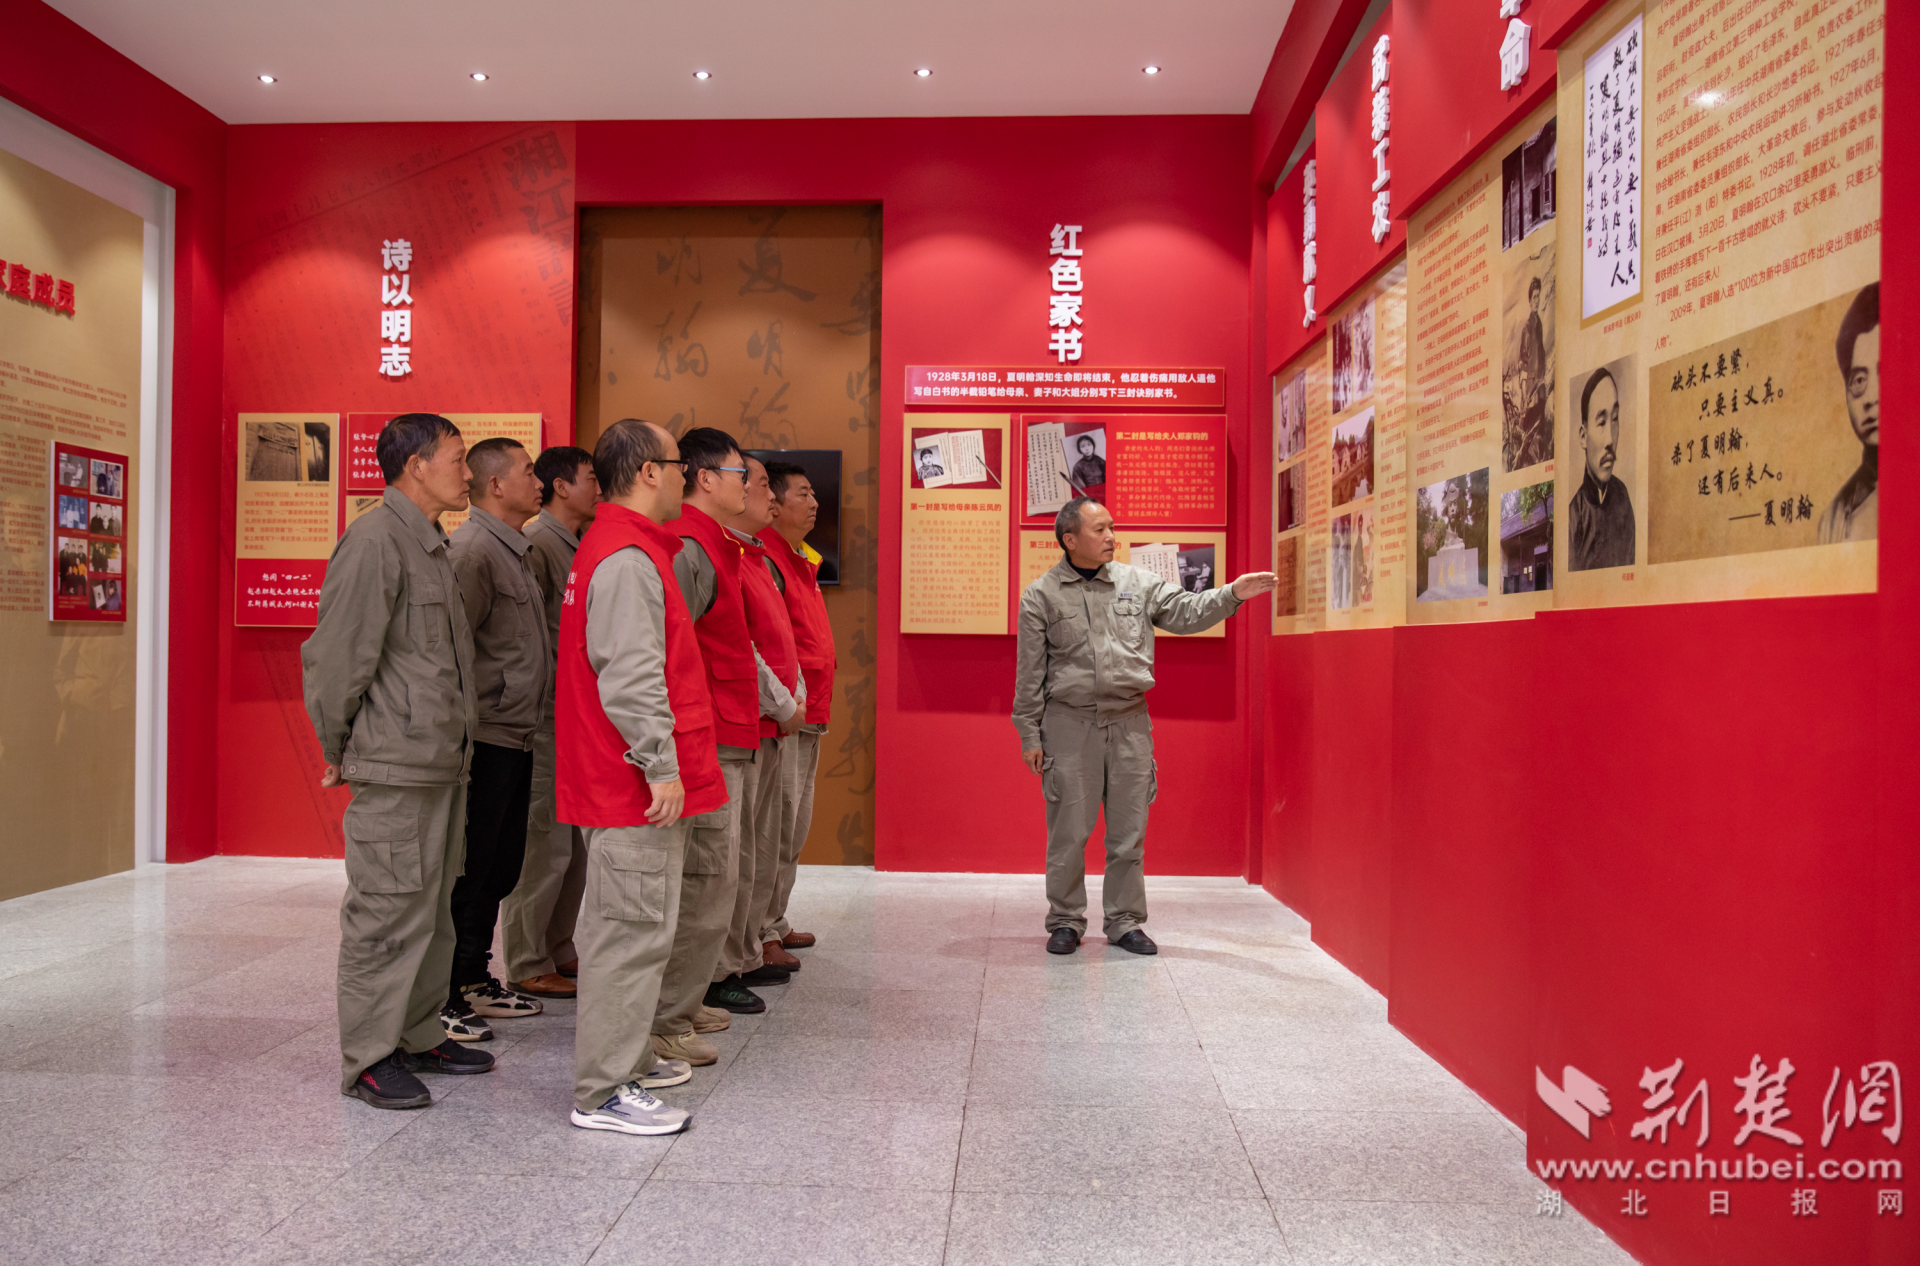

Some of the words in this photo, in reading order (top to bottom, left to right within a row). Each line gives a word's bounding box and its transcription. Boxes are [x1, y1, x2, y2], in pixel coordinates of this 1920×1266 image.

[378, 238, 414, 376] 诗以明志
[1048, 223, 1084, 363] 红色家书
